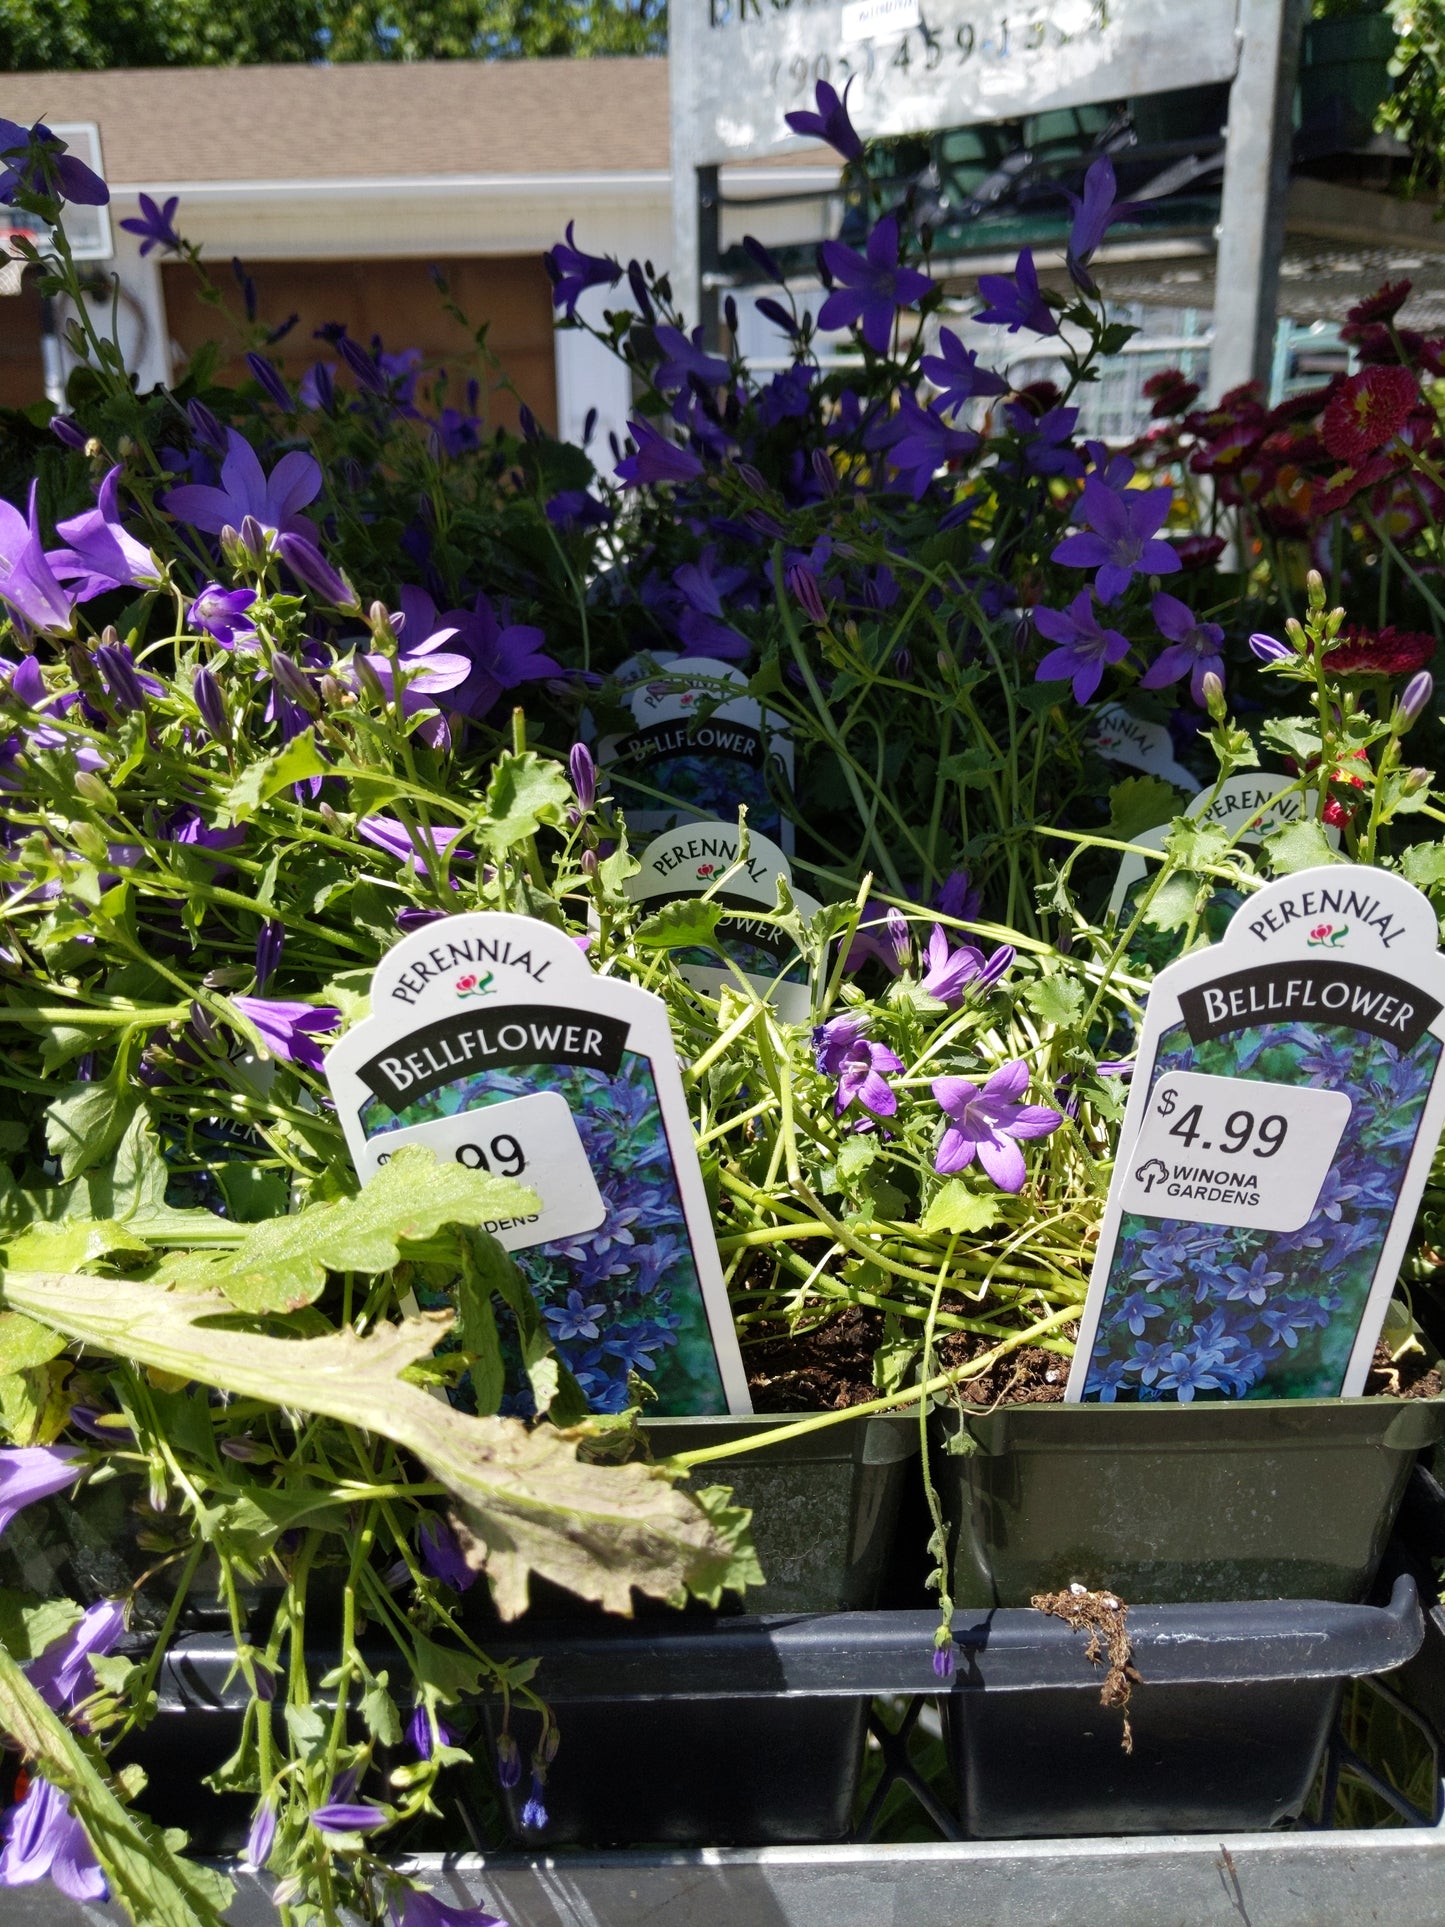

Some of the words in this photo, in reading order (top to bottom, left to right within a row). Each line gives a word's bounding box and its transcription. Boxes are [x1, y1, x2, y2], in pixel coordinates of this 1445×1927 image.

[1098, 716, 1154, 756] NNIAL
[1204, 790, 1299, 822] PERENNI
[652, 839, 768, 883] PERENNAL
[1249, 889, 1406, 948] PERENNIAL
[392, 938, 552, 1005] PERENNIAL
[1203, 980, 1415, 1032] BELLFLOWER
[378, 1024, 602, 1091] BELLFLOWER
[1157, 1089, 1288, 1158] $4.99
[1167, 1183, 1260, 1206] GARDENS
[1173, 1165, 1258, 1189] WINONA
[483, 1214, 539, 1234] DENS
